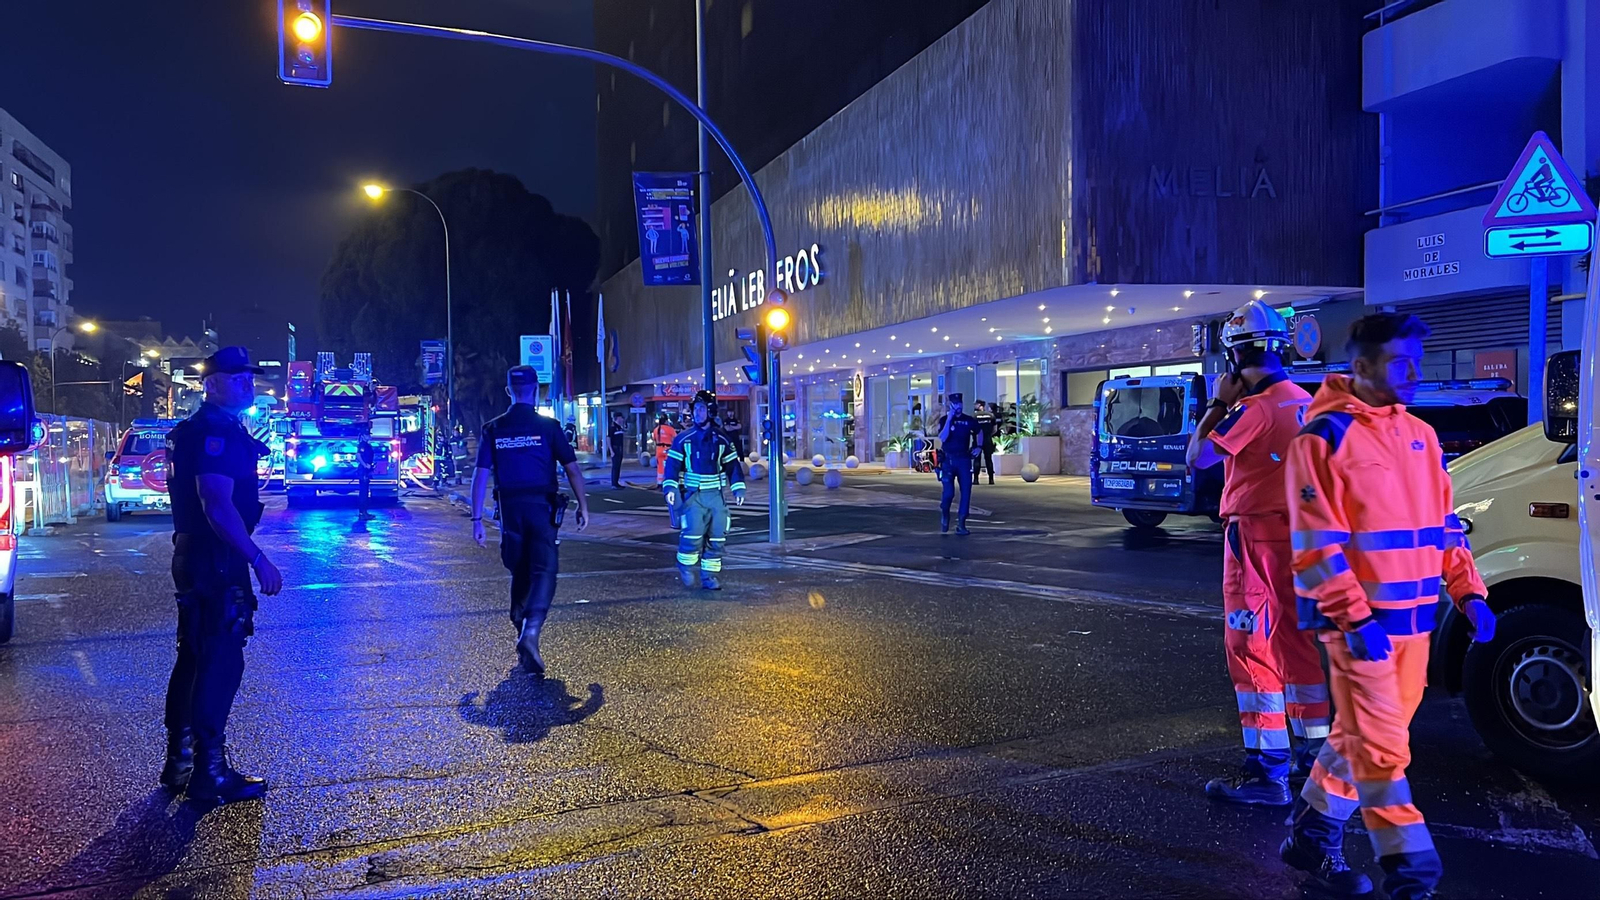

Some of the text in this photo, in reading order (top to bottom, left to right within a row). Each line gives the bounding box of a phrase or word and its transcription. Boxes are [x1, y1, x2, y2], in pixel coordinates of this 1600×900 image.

[1417, 234, 1444, 248] LUIS
[1424, 251, 1439, 263] DE
[1404, 262, 1459, 281] MORALES
[1483, 363, 1508, 371] SALIDA
[495, 435, 532, 444] POLICIA
[495, 440, 543, 450] NACIONAL
[1111, 461, 1158, 471] POLICIA
